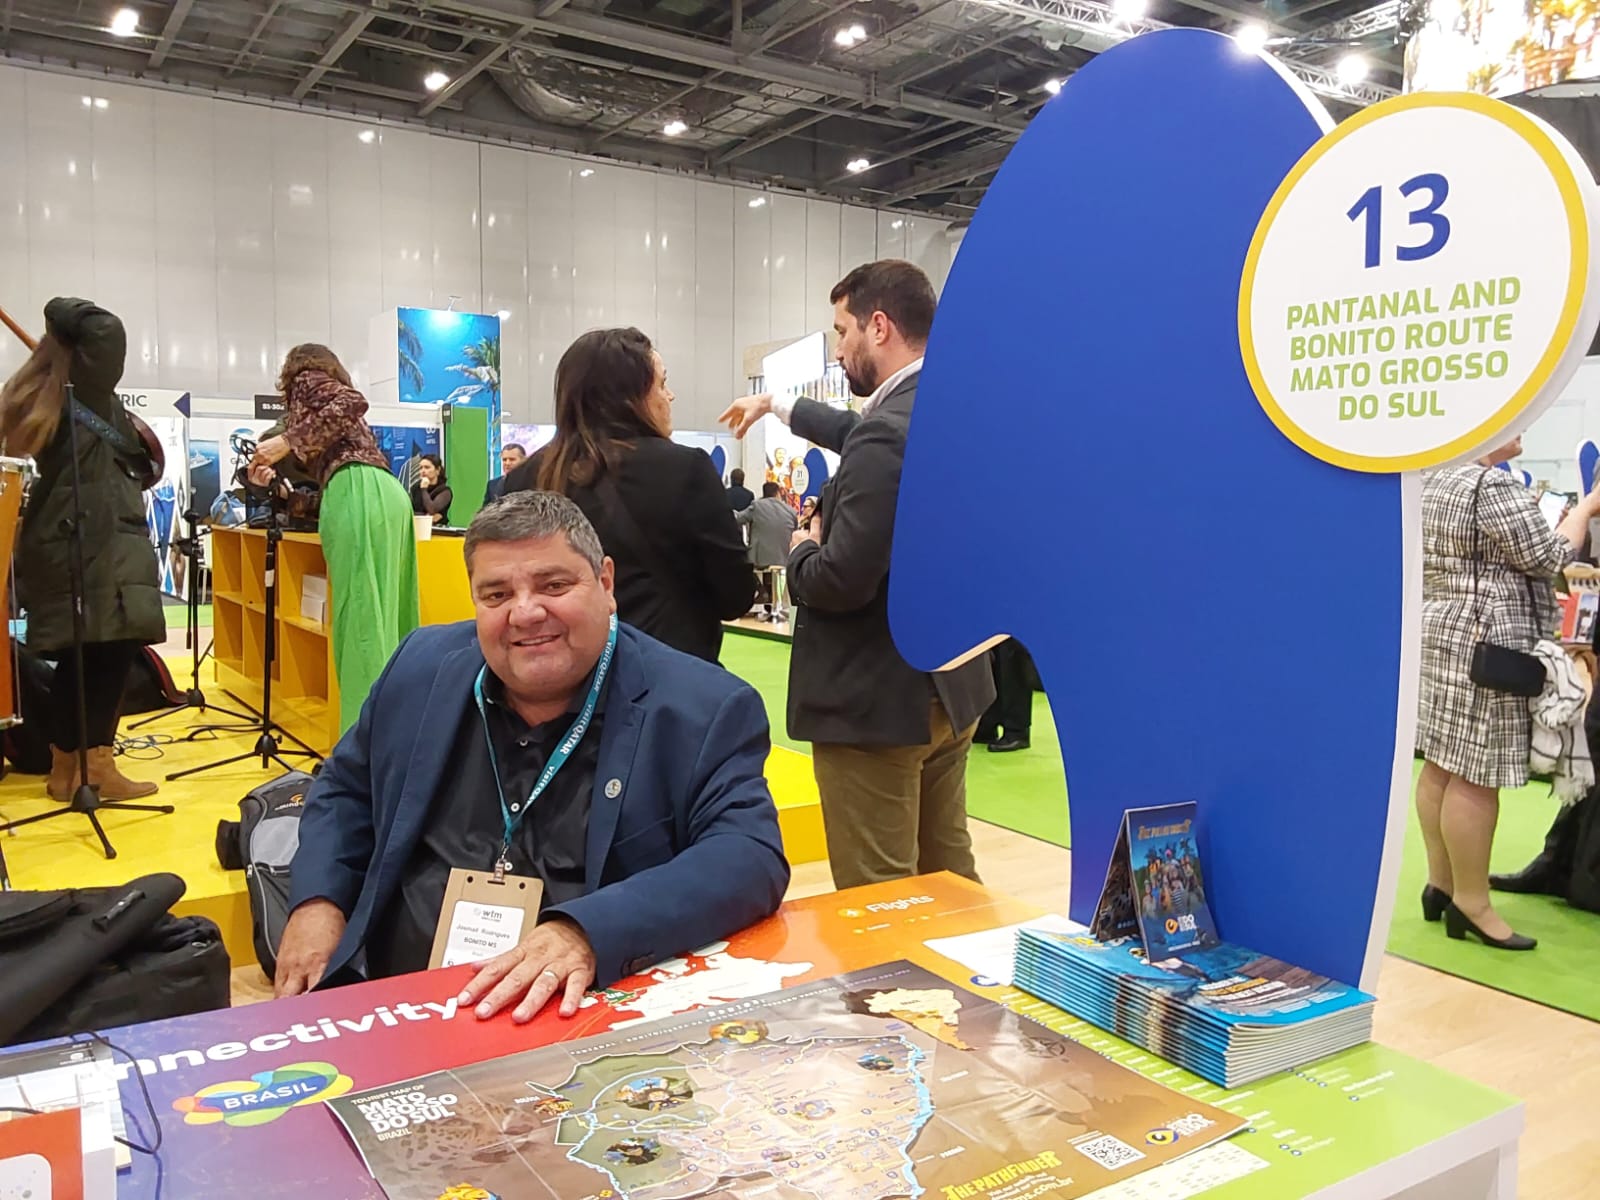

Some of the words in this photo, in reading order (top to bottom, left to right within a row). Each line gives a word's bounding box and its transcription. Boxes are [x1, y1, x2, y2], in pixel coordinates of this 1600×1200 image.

[1346, 173, 1451, 268] 13
[1286, 287, 1439, 330] PANTANAL
[1448, 276, 1521, 309] AND
[1289, 326, 1395, 361] BONITO
[1405, 313, 1513, 350] ROUTE
[1290, 361, 1370, 392] MATO
[1380, 350, 1509, 384] GROSSO
[118, 394, 148, 408] RIC
[1339, 395, 1378, 421] DO
[1388, 390, 1445, 419] SUL
[865, 895, 935, 912] Flights
[114, 997, 459, 1080] nnectivity
[224, 1081, 318, 1110] BRASIL
[350, 1092, 391, 1105] TOURIST
[391, 1087, 411, 1096] MAP
[357, 1092, 426, 1114] MATO
[365, 1094, 458, 1121] GROSSO
[370, 1115, 409, 1133] DO
[409, 1105, 456, 1124] SUL
[377, 1128, 412, 1142] BRAZIL
[940, 1183, 978, 1200] THE
[971, 1150, 1063, 1192] PATHFINDER
